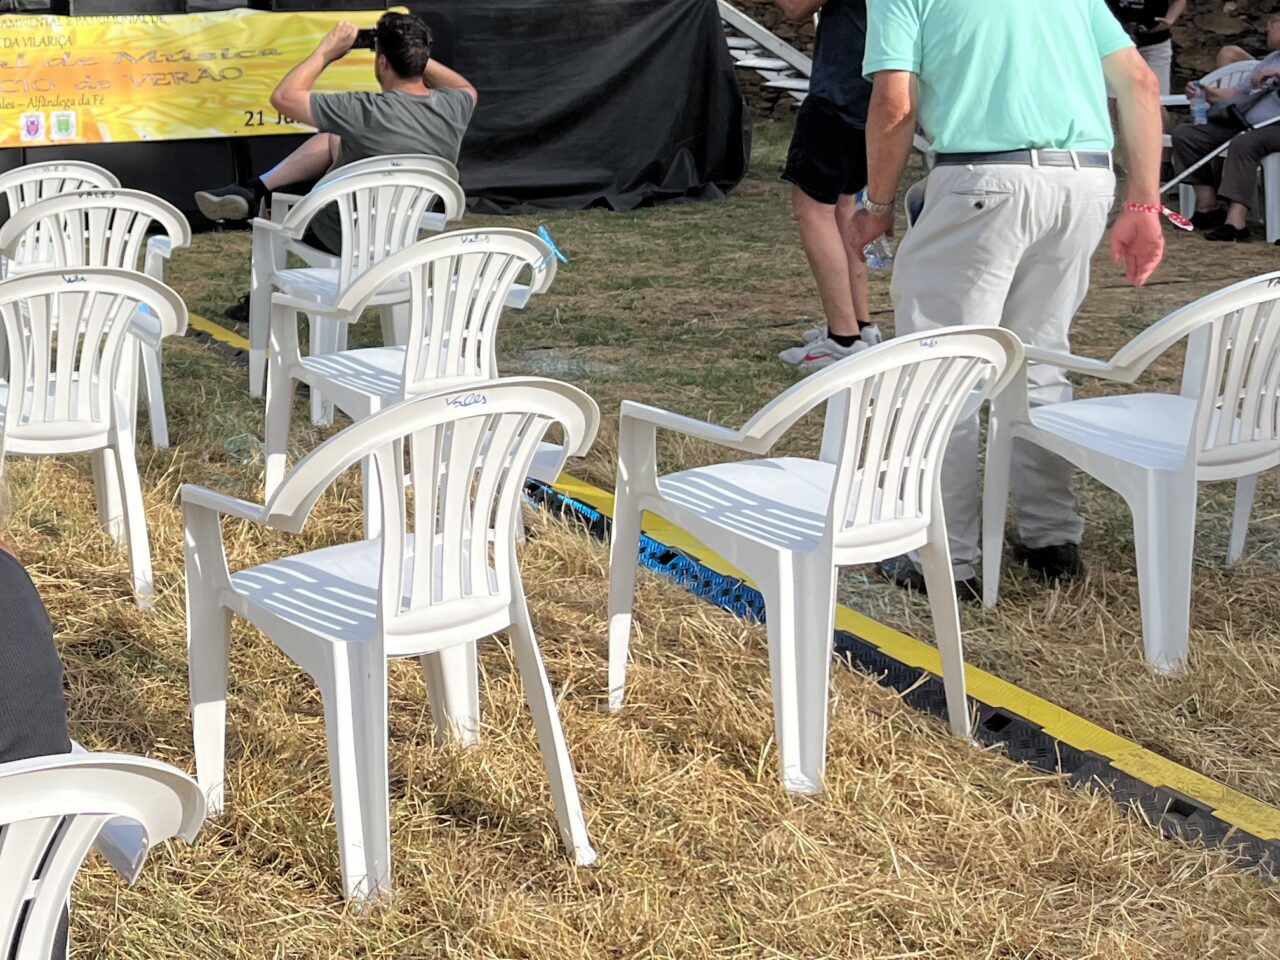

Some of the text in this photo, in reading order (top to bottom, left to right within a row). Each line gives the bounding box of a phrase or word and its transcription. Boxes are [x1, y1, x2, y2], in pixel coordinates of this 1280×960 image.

[4, 37, 20, 49] DA
[23, 34, 73, 49] VILARIÇA
[42, 50, 100, 68] de
[111, 47, 283, 67] Música
[73, 74, 113, 91] de
[123, 65, 244, 89] VERÃO
[78, 94, 91, 106] da
[92, 94, 105, 106] Fé
[243, 109, 301, 127] 21 Ju
[77, 191, 116, 199] VALES
